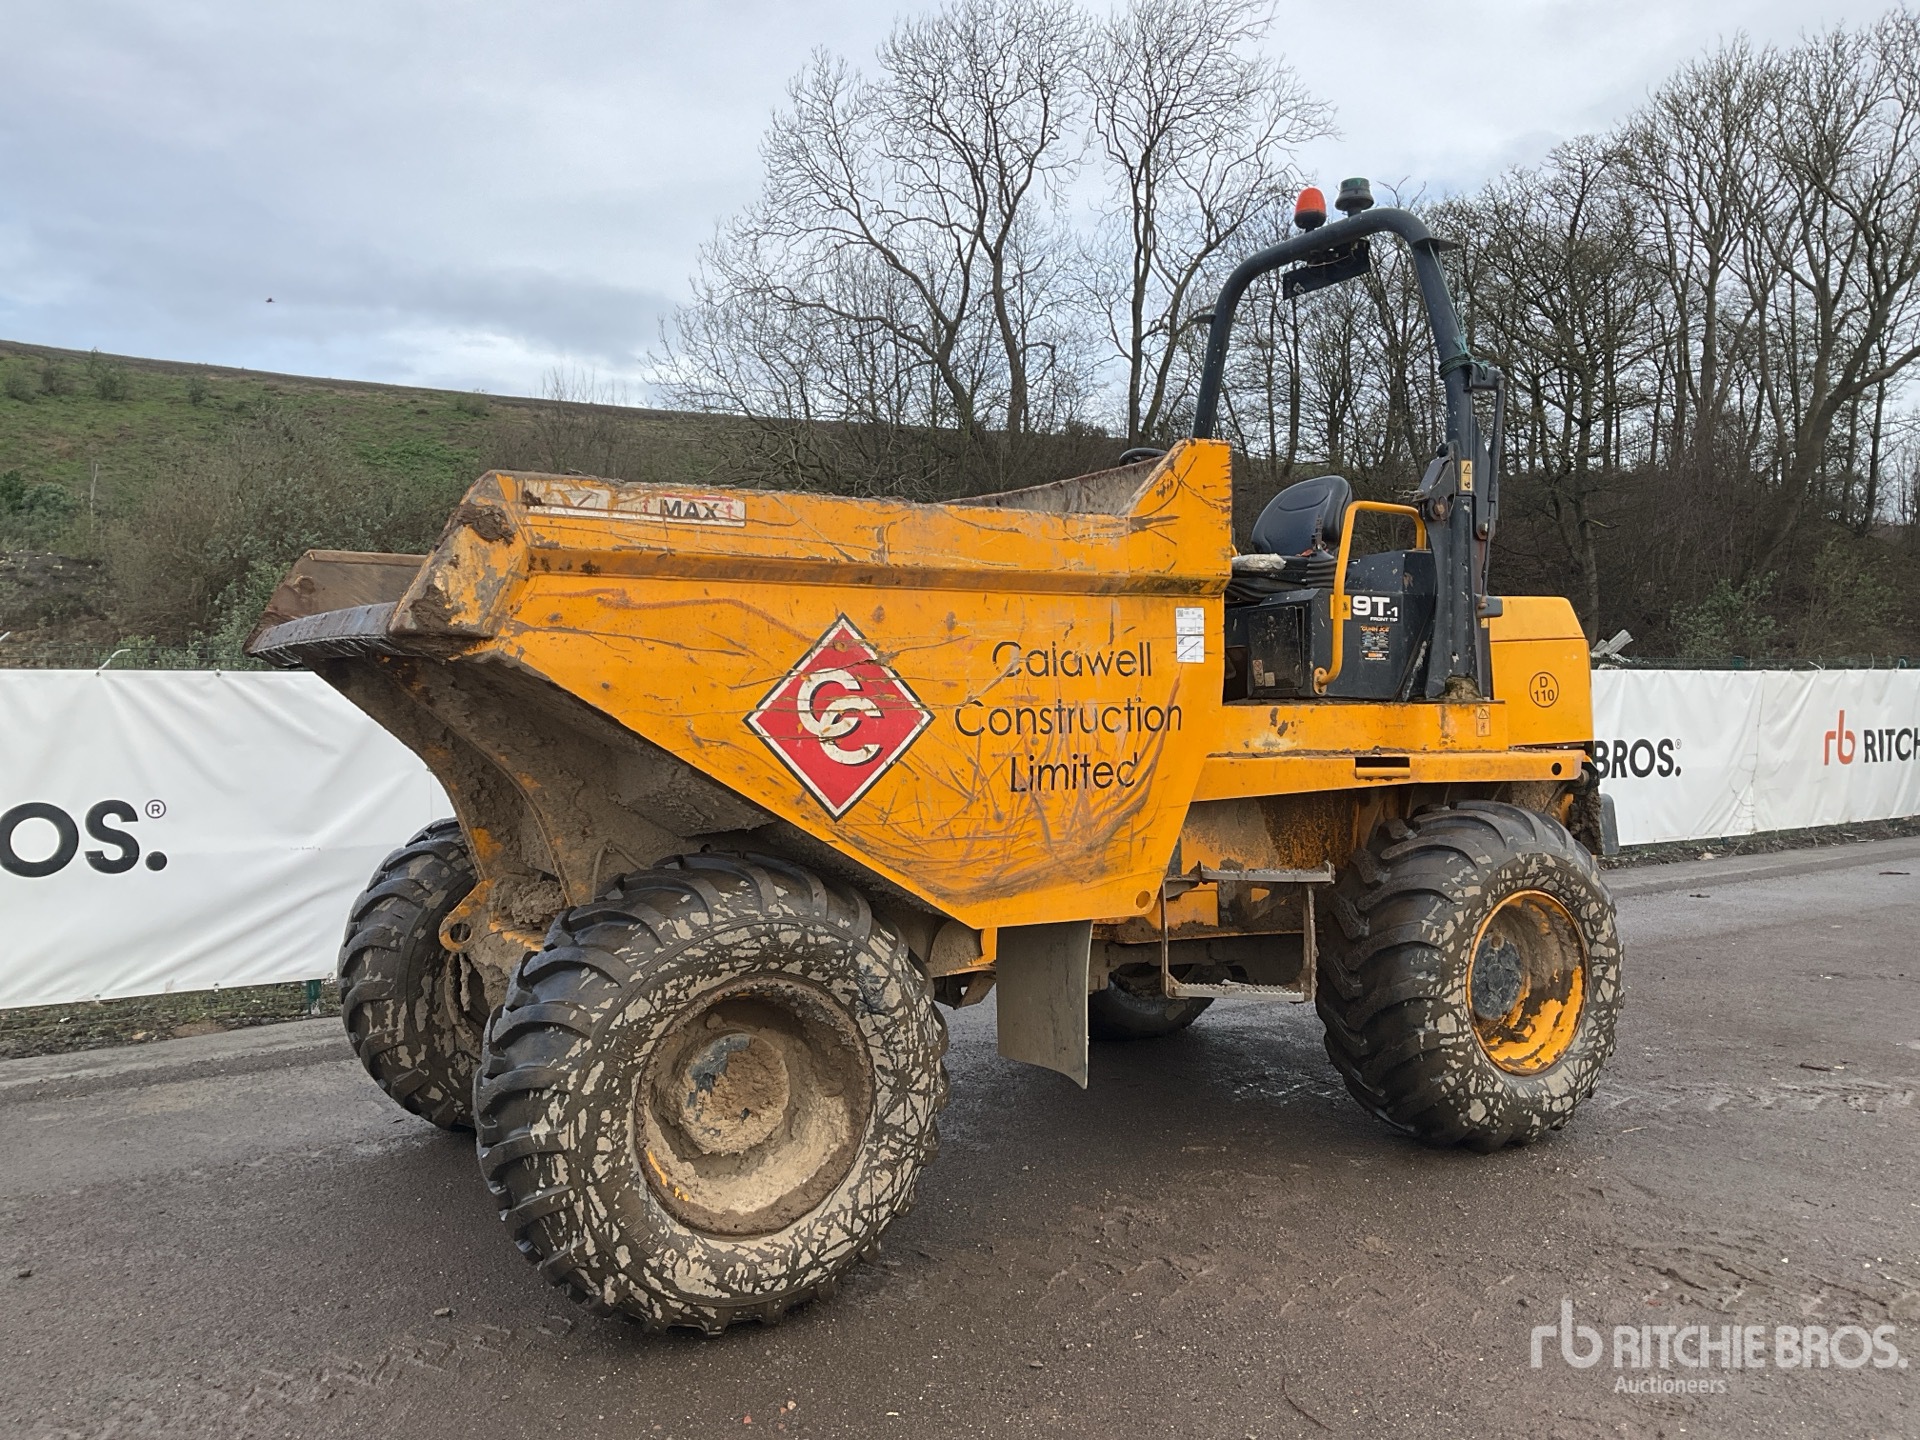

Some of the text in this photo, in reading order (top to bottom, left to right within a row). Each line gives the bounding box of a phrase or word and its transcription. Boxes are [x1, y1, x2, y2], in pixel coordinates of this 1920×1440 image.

[660, 499, 719, 521] MAX
[1539, 676, 1548, 688] D
[1534, 689, 1555, 701] 110
[954, 697, 1182, 737] Construction
[1010, 752, 1138, 792] Limited
